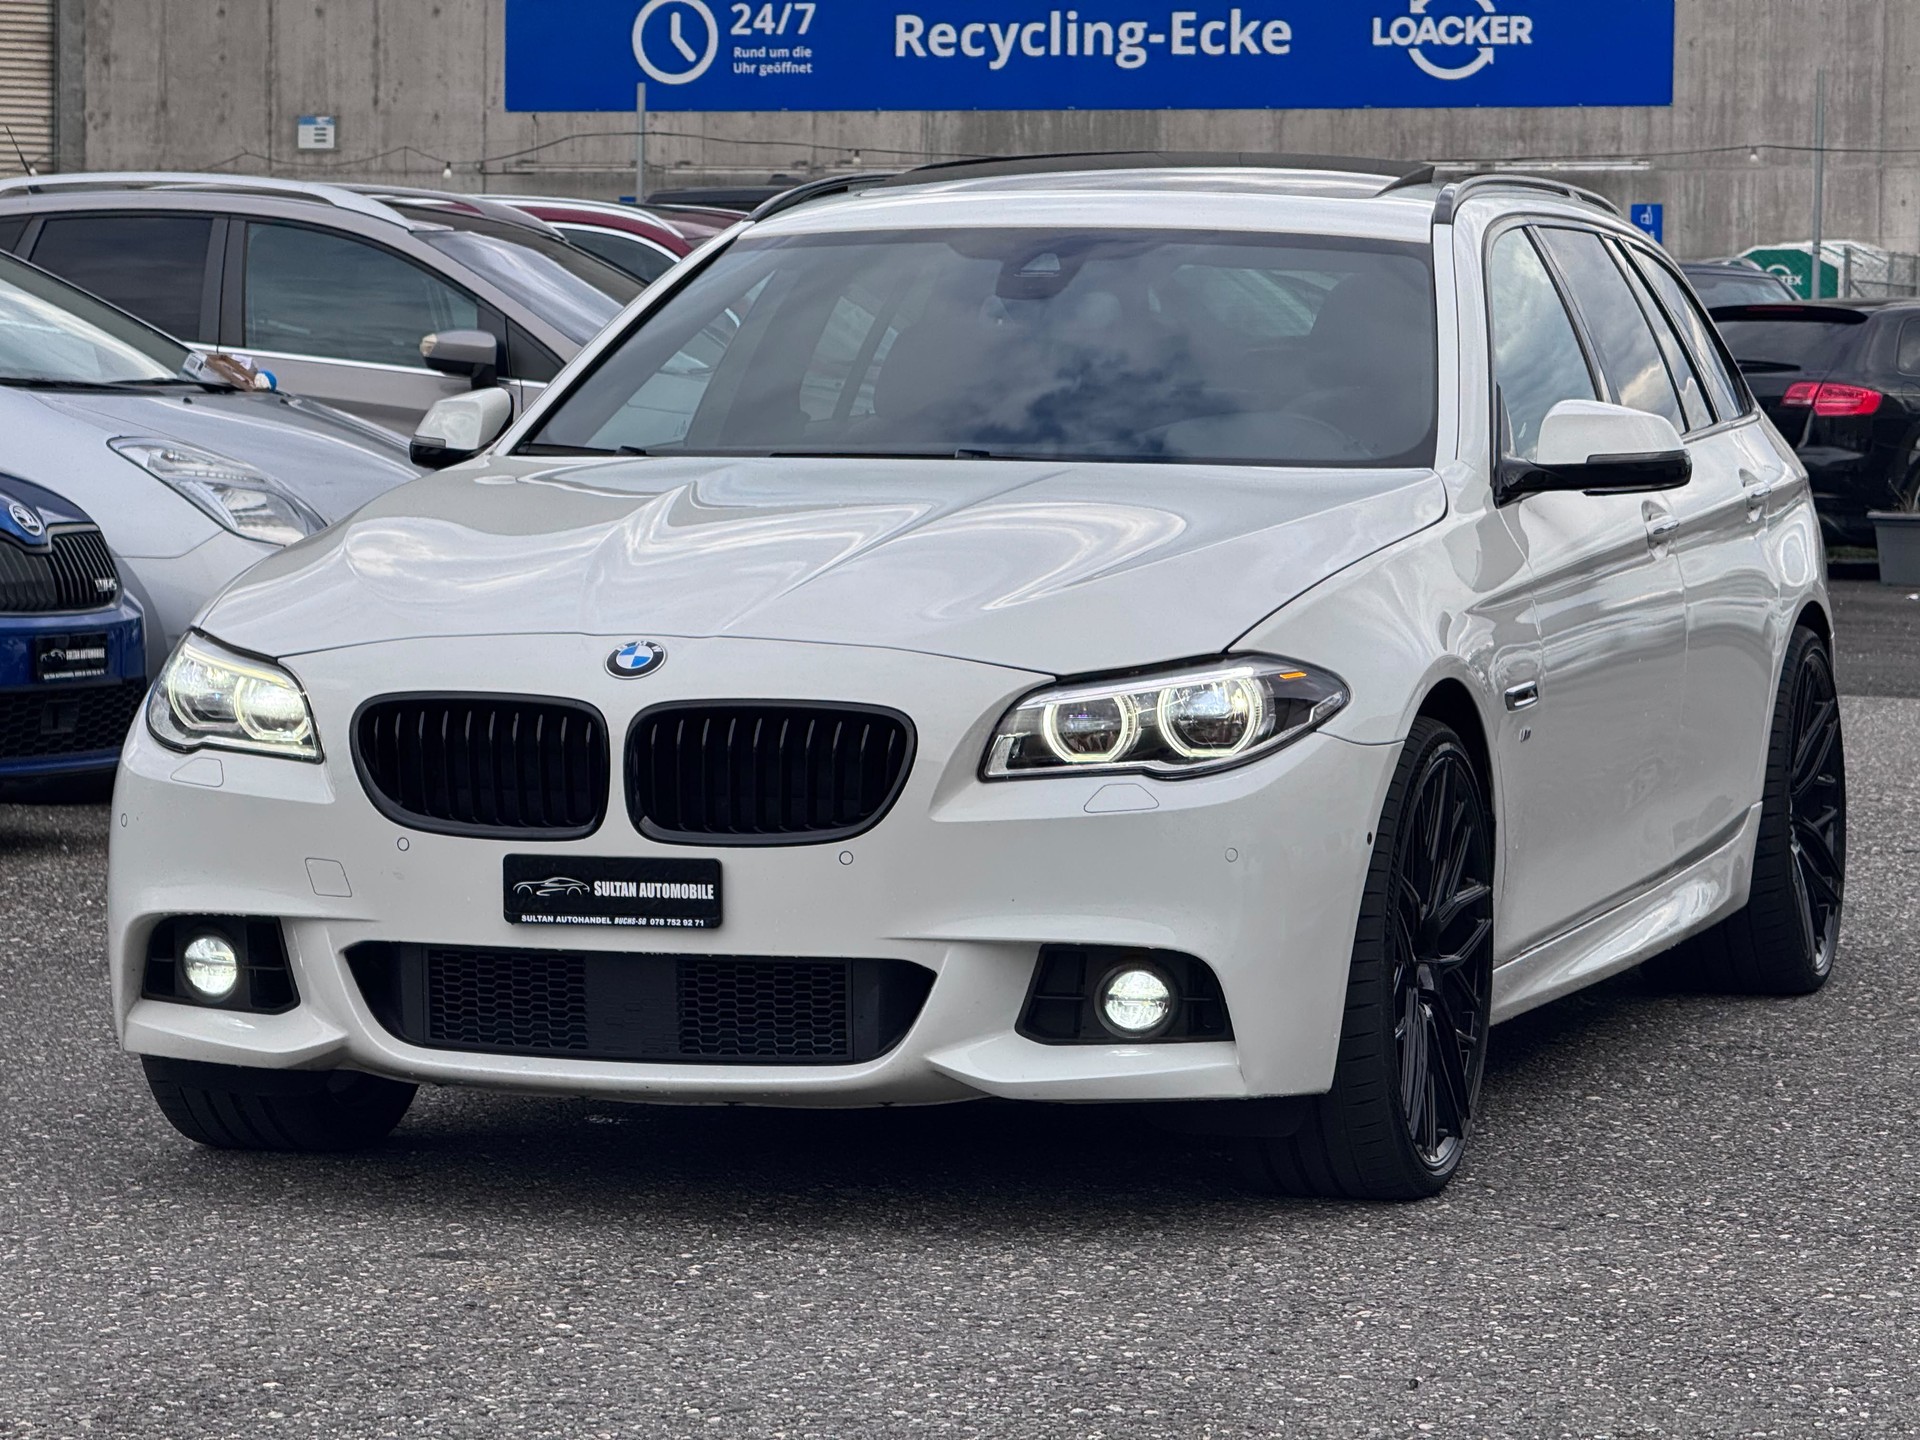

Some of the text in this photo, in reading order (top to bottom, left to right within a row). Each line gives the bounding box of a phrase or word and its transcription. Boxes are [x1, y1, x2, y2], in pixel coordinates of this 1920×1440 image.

[730, 3, 816, 35] 24/7
[895, 9, 1292, 70] Recycling-Ecke
[1372, 15, 1533, 46] LOACKER
[733, 46, 812, 58] Rund um die
[733, 61, 813, 77] Uhr geöffnet
[593, 880, 715, 900] SULTAN AUTOMOBILE
[521, 914, 554, 923] SULTAN
[555, 916, 612, 925] AUTOHANDEL
[650, 918, 665, 926] 078
[667, 918, 681, 927] 752
[682, 919, 693, 927] 92
[694, 919, 705, 927] 71
